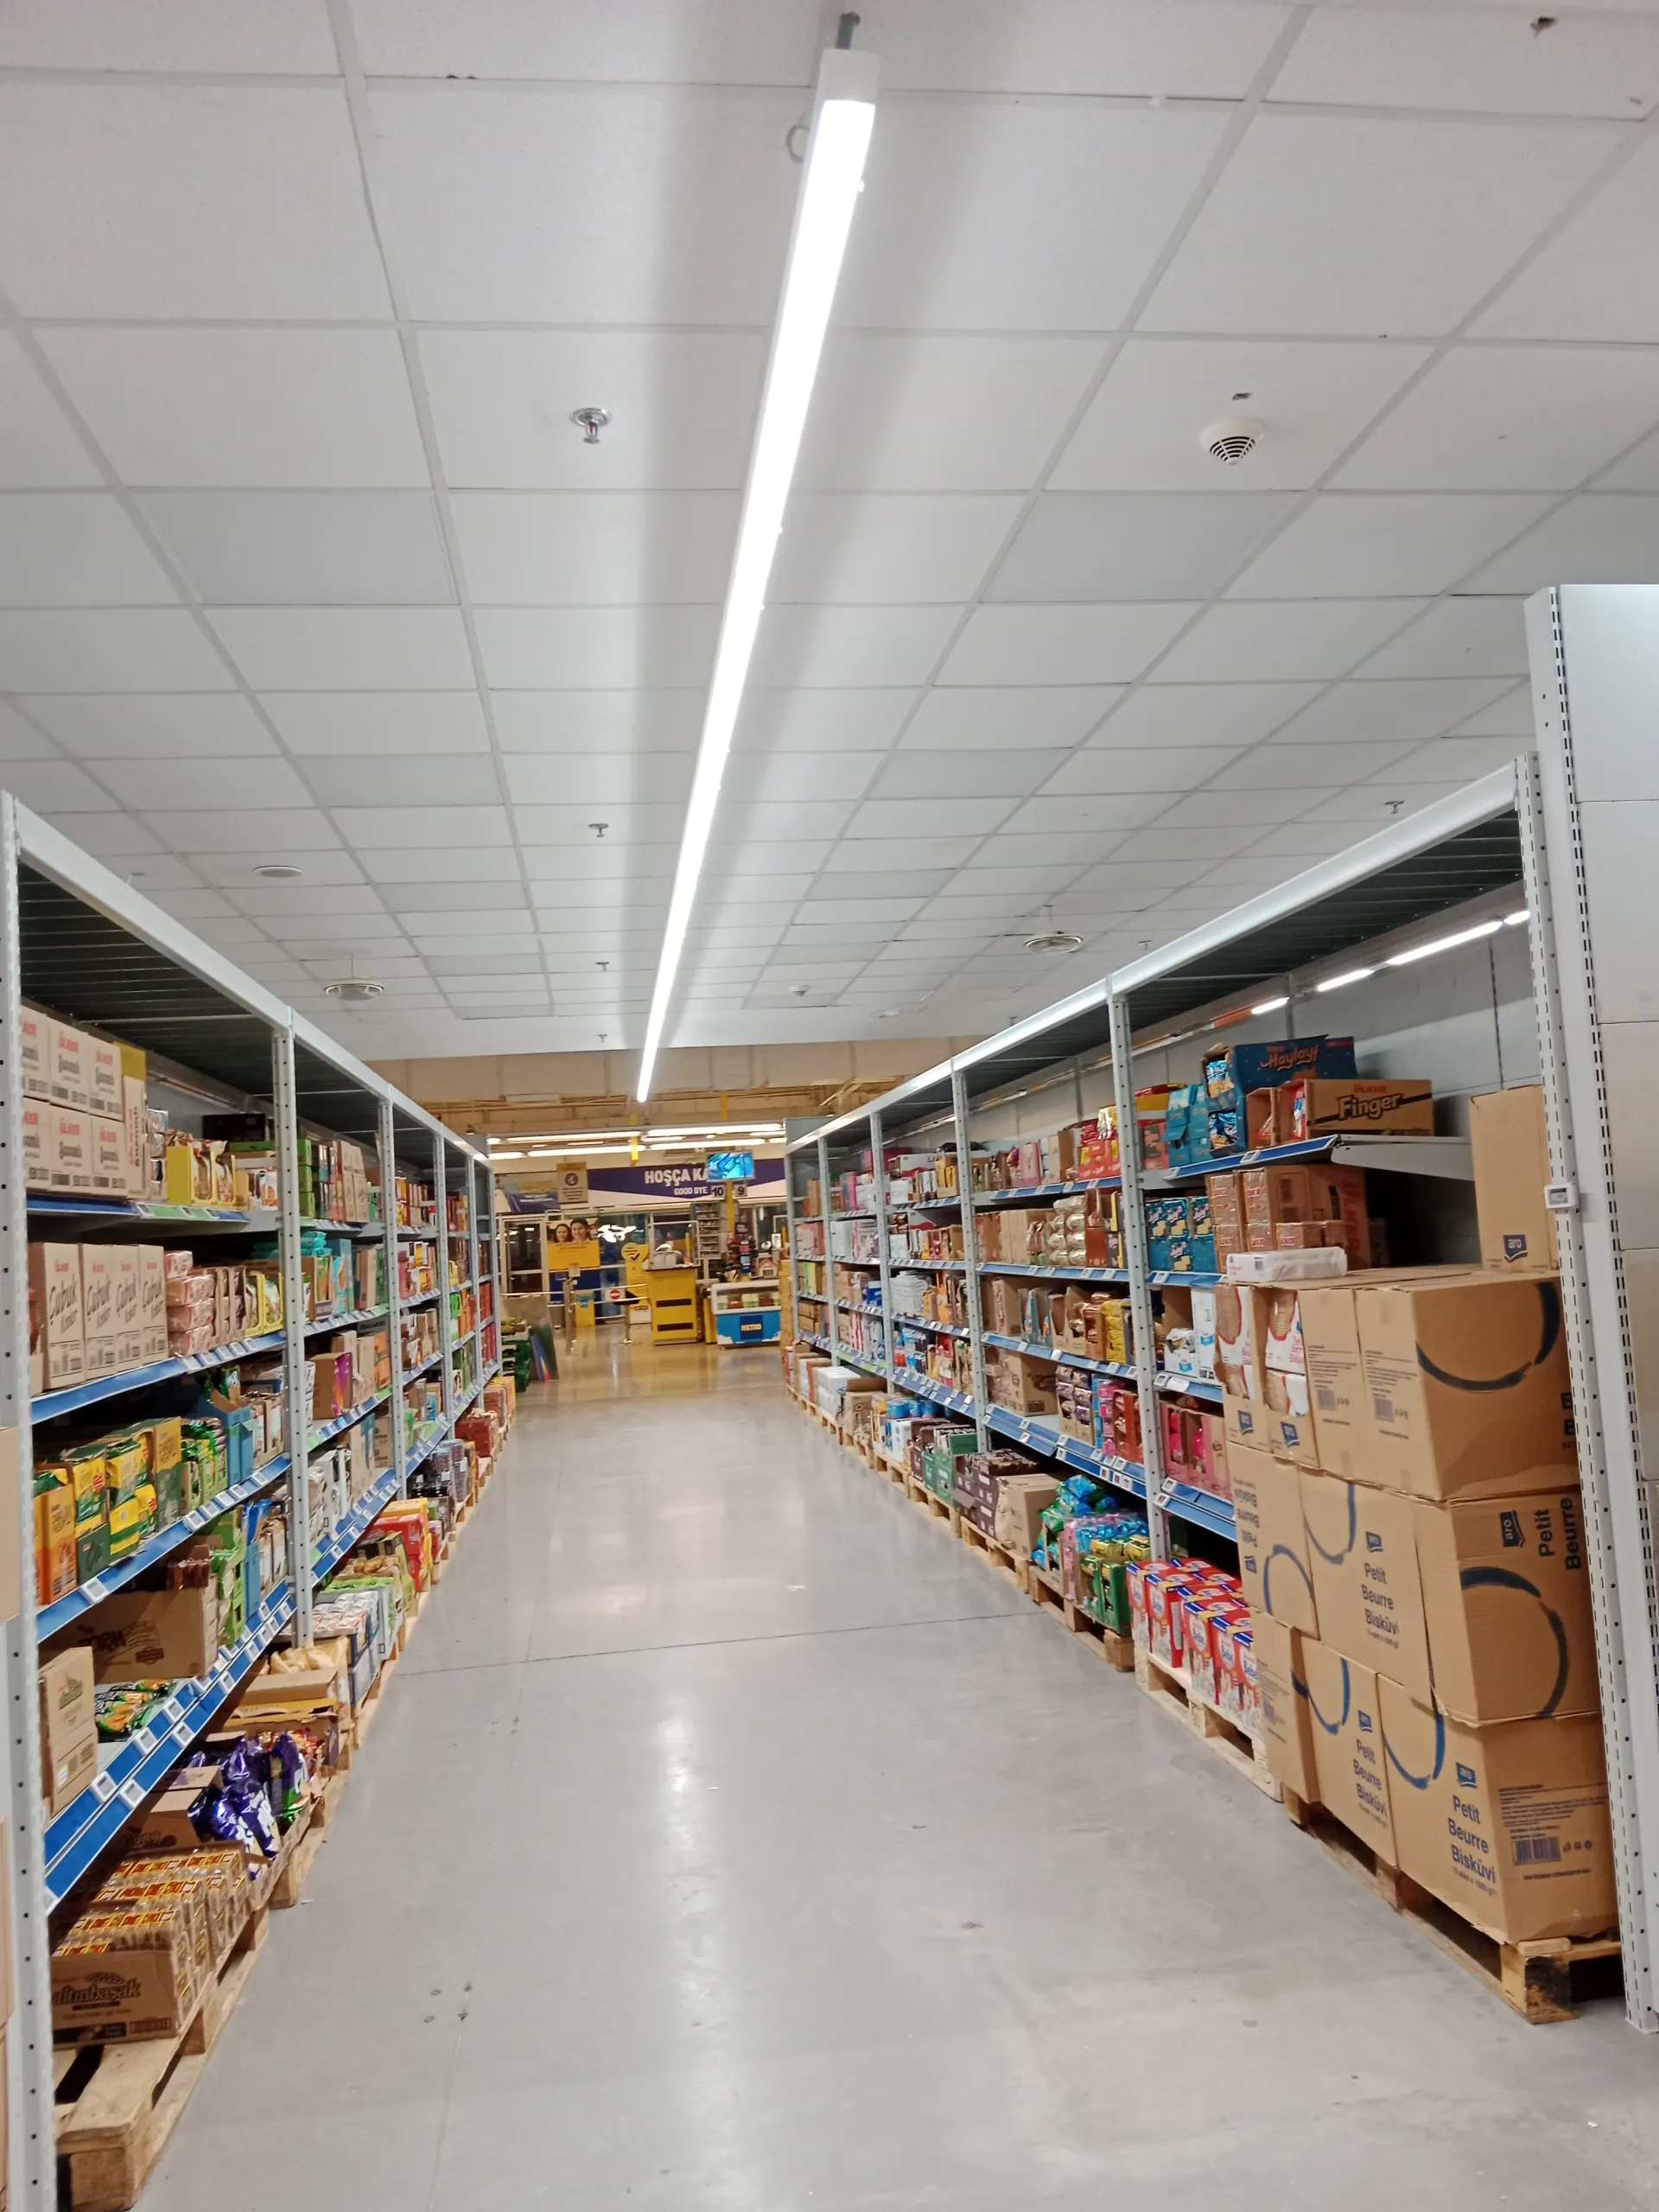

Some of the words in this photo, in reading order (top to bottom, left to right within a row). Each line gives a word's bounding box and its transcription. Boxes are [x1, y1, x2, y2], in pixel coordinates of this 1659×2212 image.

[1338, 1094, 1402, 1121] Finger
[645, 1167, 691, 1187] HOŞÇA
[694, 1185, 709, 1195] BYE
[712, 1187, 724, 1196] 10
[738, 1187, 745, 1196] 9
[1503, 1518, 1514, 1541] aro
[1534, 1509, 1555, 1557] Petit
[1560, 1497, 1581, 1571] Beurre
[1364, 1561, 1387, 1585] Petit
[1361, 1584, 1394, 1611] Beurre
[1364, 1608, 1399, 1636] Bisküvi
[1356, 1738, 1376, 1764] Petit
[1353, 1758, 1382, 1791] Beurre
[1357, 1783, 1388, 1818] Bisküvi
[1452, 1795, 1481, 1825] Petit
[1447, 1817, 1490, 1854] Beurre
[1451, 1843, 1497, 1884] Bisküvi
